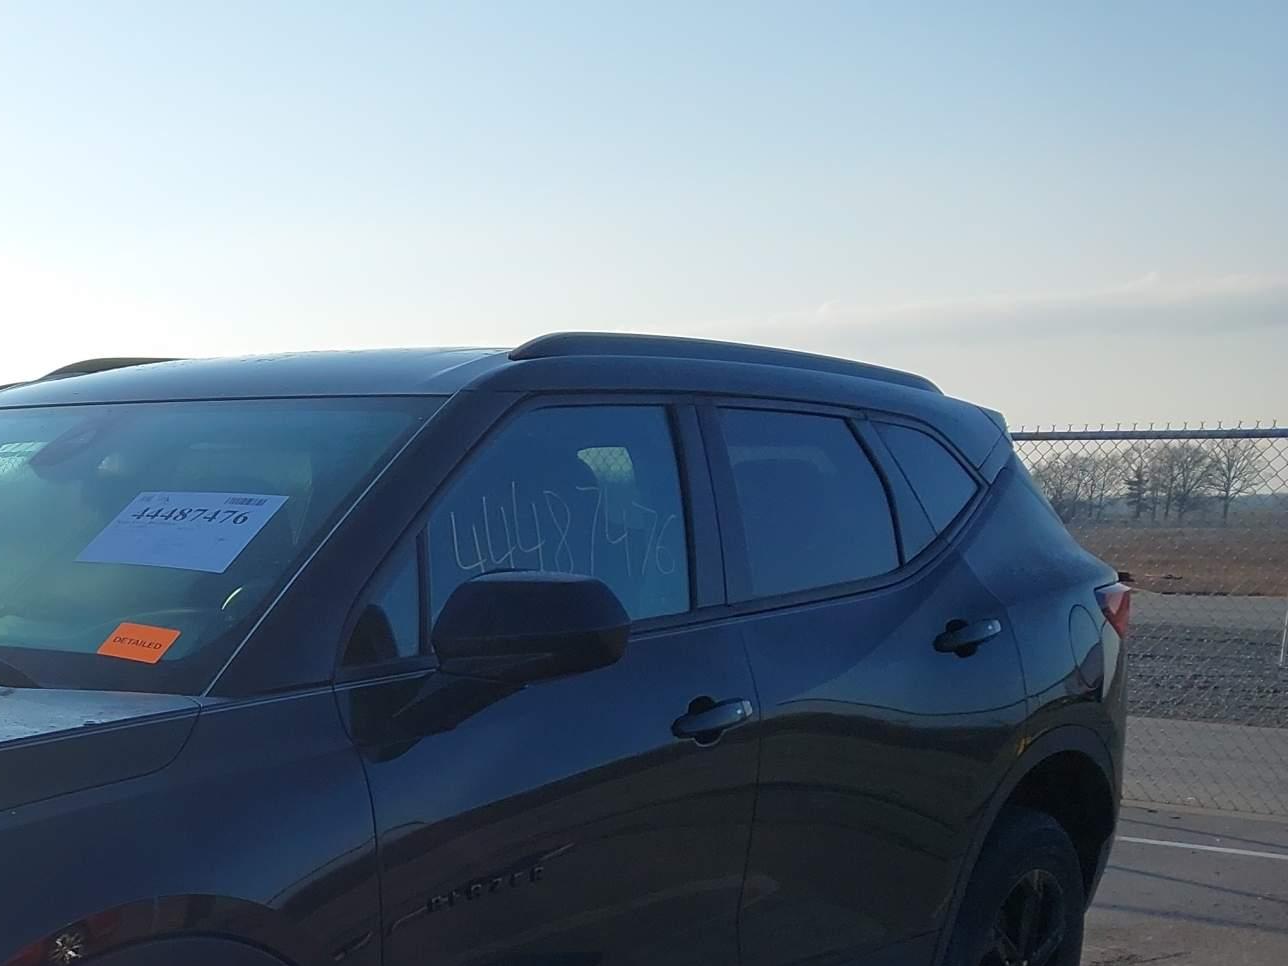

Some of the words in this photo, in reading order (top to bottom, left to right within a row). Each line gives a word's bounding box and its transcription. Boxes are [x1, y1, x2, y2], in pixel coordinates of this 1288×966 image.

[132, 506, 251, 526] 44487476
[450, 481, 676, 577] 44487476
[112, 636, 163, 650] DETAILED
